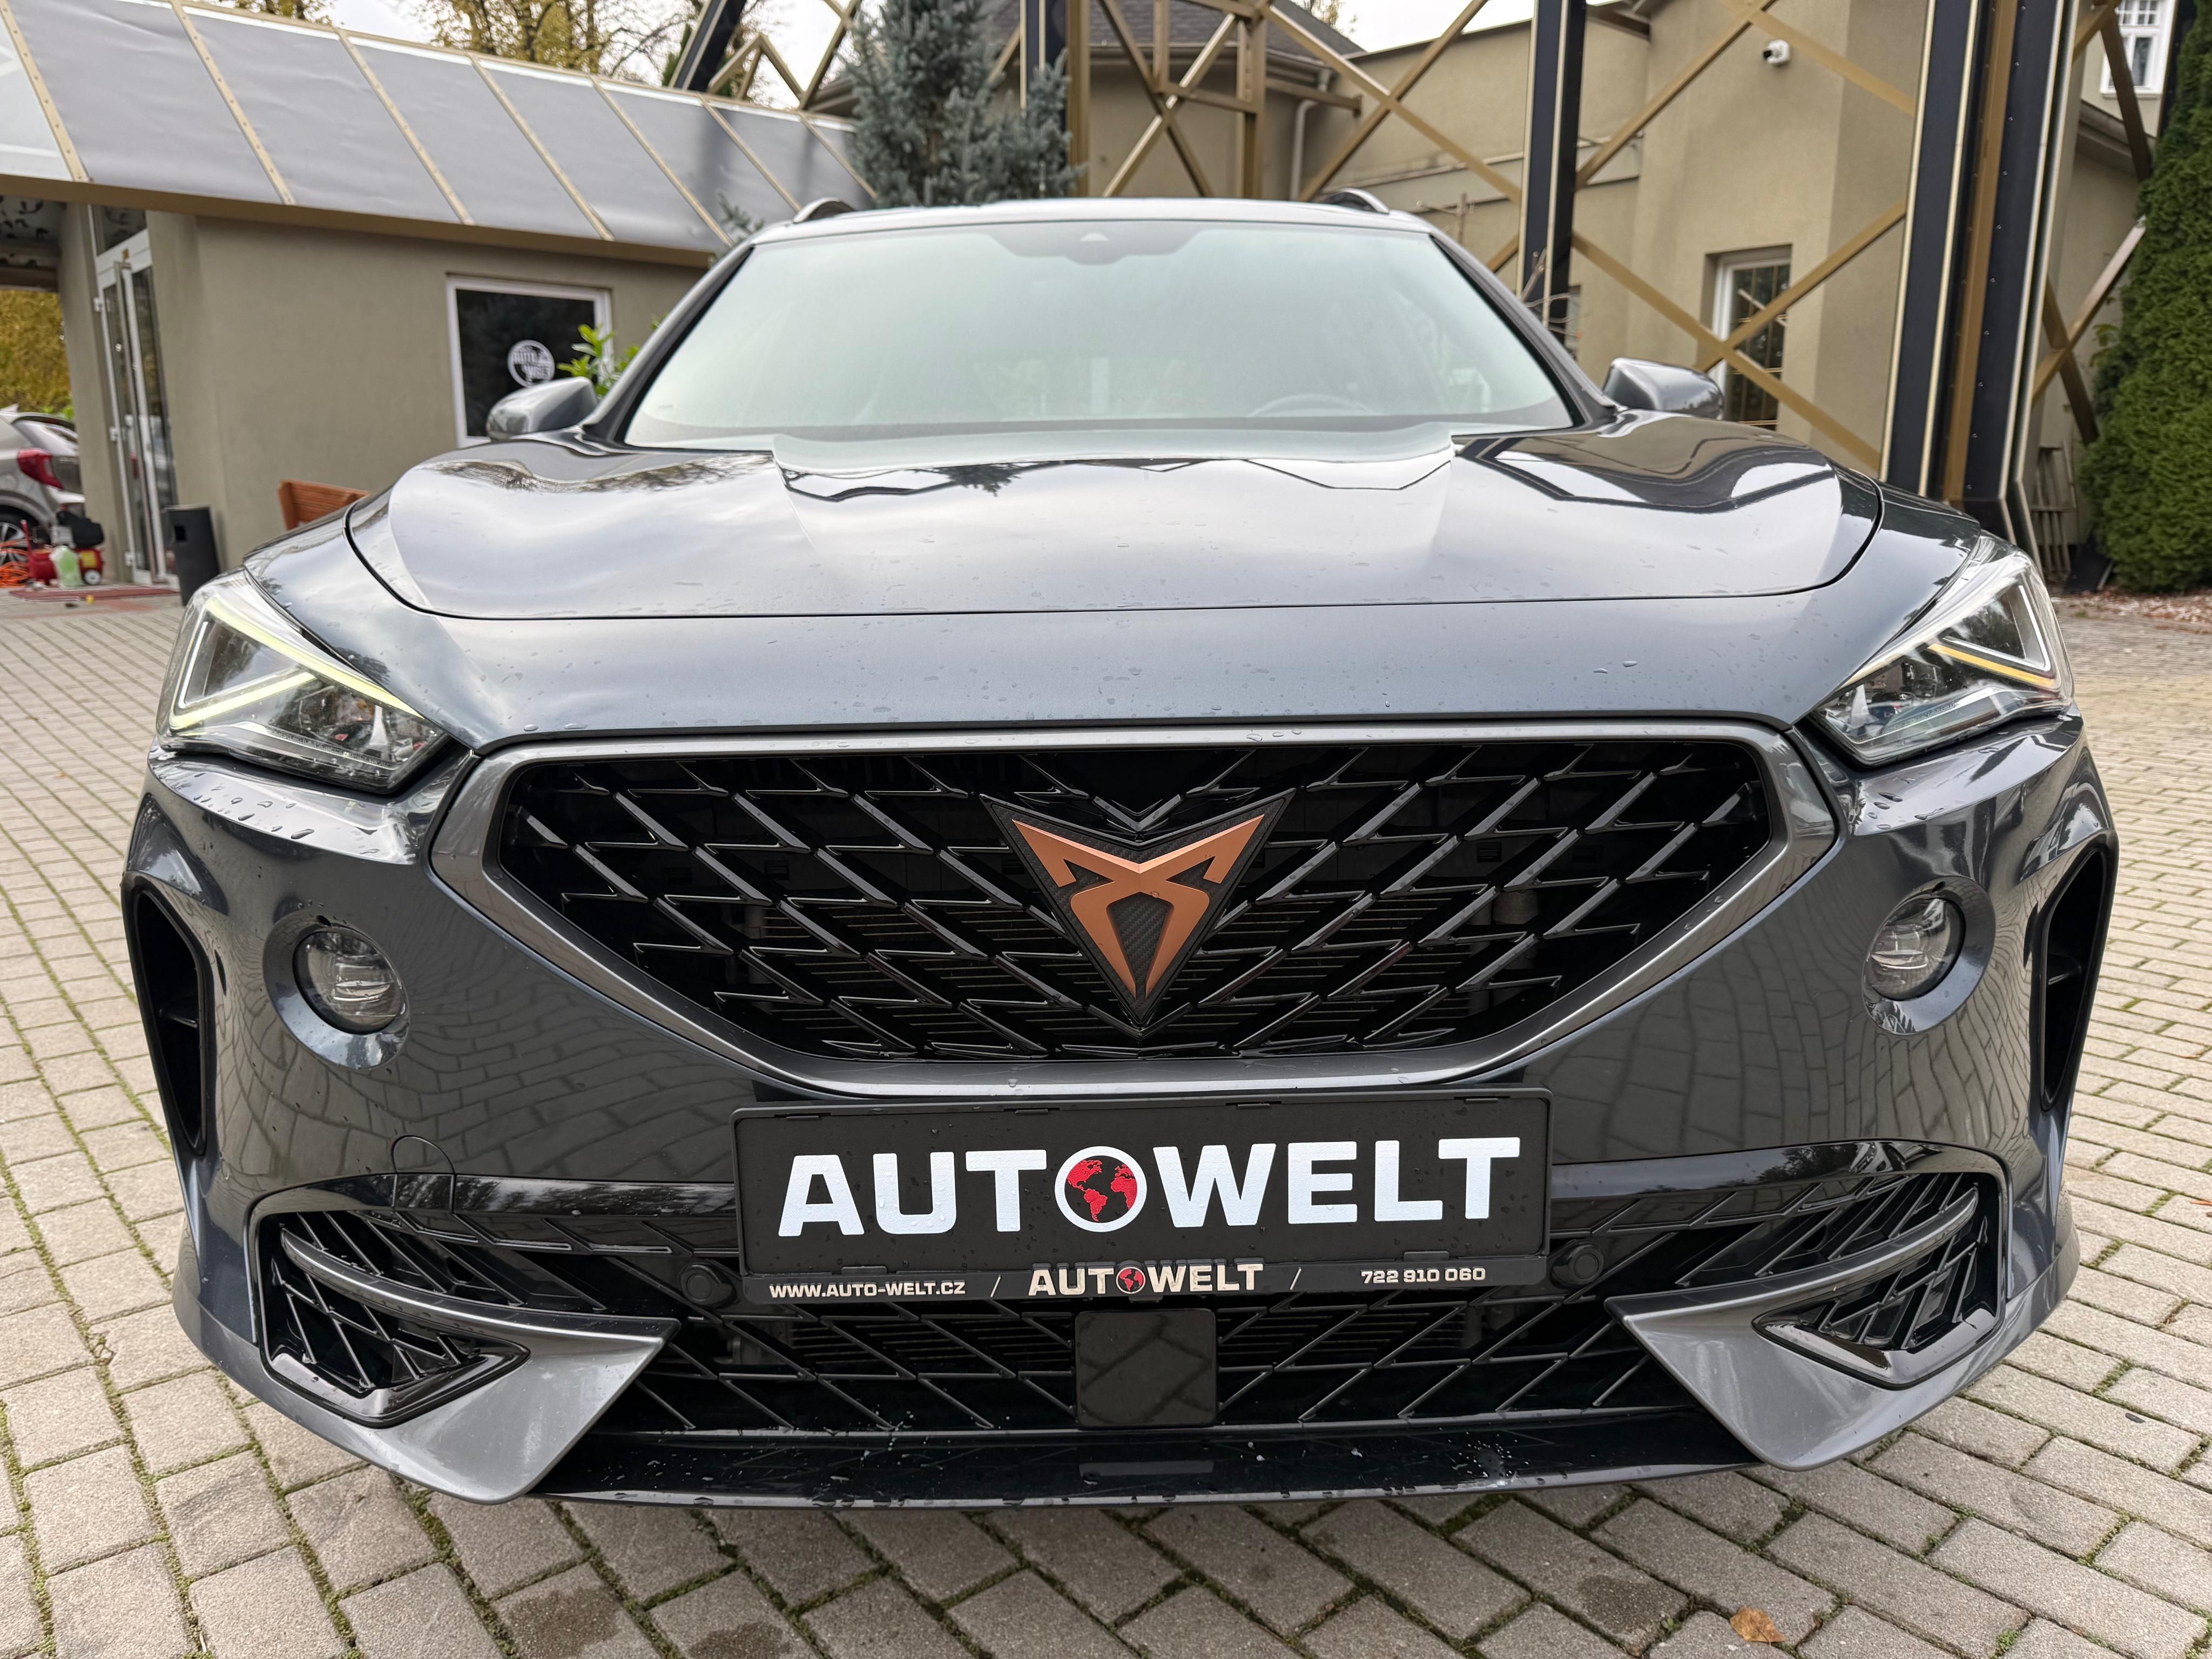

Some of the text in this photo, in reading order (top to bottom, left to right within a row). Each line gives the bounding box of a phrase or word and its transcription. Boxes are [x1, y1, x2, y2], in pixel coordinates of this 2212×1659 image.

[778, 1137, 1520, 1237] AUTOWELT
[769, 1282, 966, 1298] WWW.AUTO-WELT.CZ
[1028, 1263, 1264, 1296] AUTOWELT
[1361, 1270, 1399, 1284] 722
[1403, 1269, 1440, 1283] 910
[1445, 1267, 1486, 1282] 060
